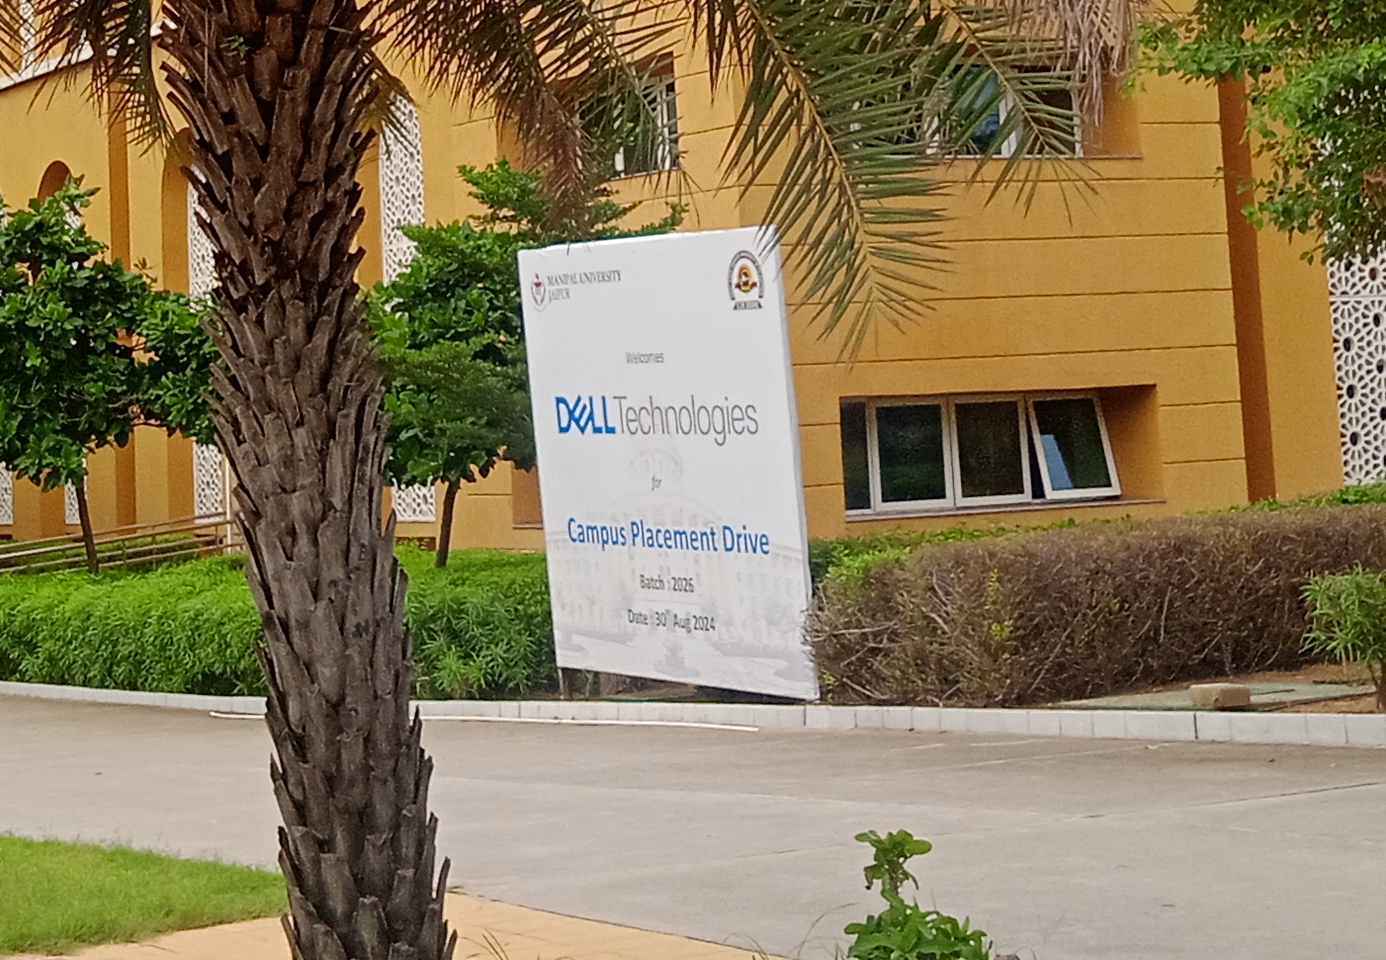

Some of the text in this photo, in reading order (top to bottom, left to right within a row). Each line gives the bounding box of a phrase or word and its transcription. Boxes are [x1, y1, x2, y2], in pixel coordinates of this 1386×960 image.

[547, 270, 621, 286] MANIPAL UNIVERSITY
[548, 288, 570, 304] JAIPUR
[625, 351, 665, 364] Welcomes
[555, 394, 759, 447] DELL Technologies
[651, 475, 662, 491] for
[568, 517, 770, 555] Campus Placement Drive
[639, 574, 665, 590] Batch
[671, 576, 694, 593] 2026
[628, 609, 649, 625] Date
[673, 613, 691, 633] Aug
[692, 615, 716, 631] 2024
